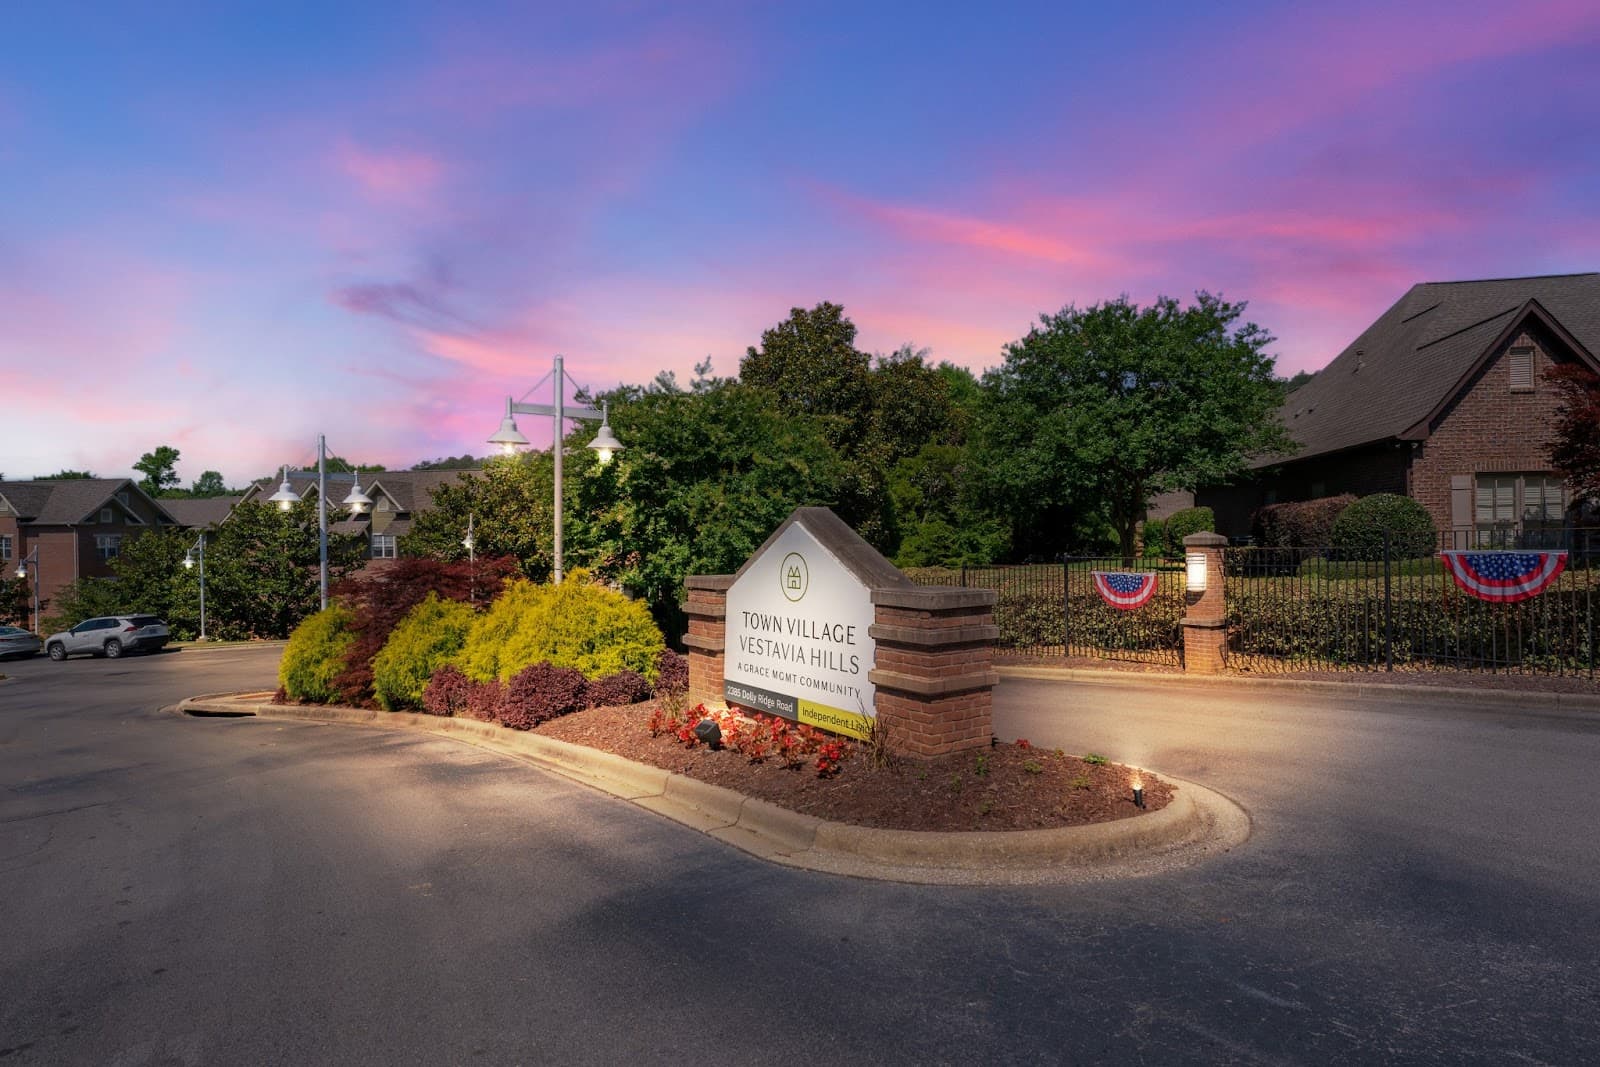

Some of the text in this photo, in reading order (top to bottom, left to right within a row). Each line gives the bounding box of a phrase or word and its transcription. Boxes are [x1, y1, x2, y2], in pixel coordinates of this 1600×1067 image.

[742, 611, 856, 645] TOWN VILLAGE
[739, 635, 860, 675] VESTAVIA HILLS
[737, 662, 861, 699] A GRACE MGMT COMMUNITY
[742, 688, 756, 704] Dolly
[758, 693, 775, 708] Ridge
[776, 699, 793, 712] Road
[802, 706, 849, 728] Independent
